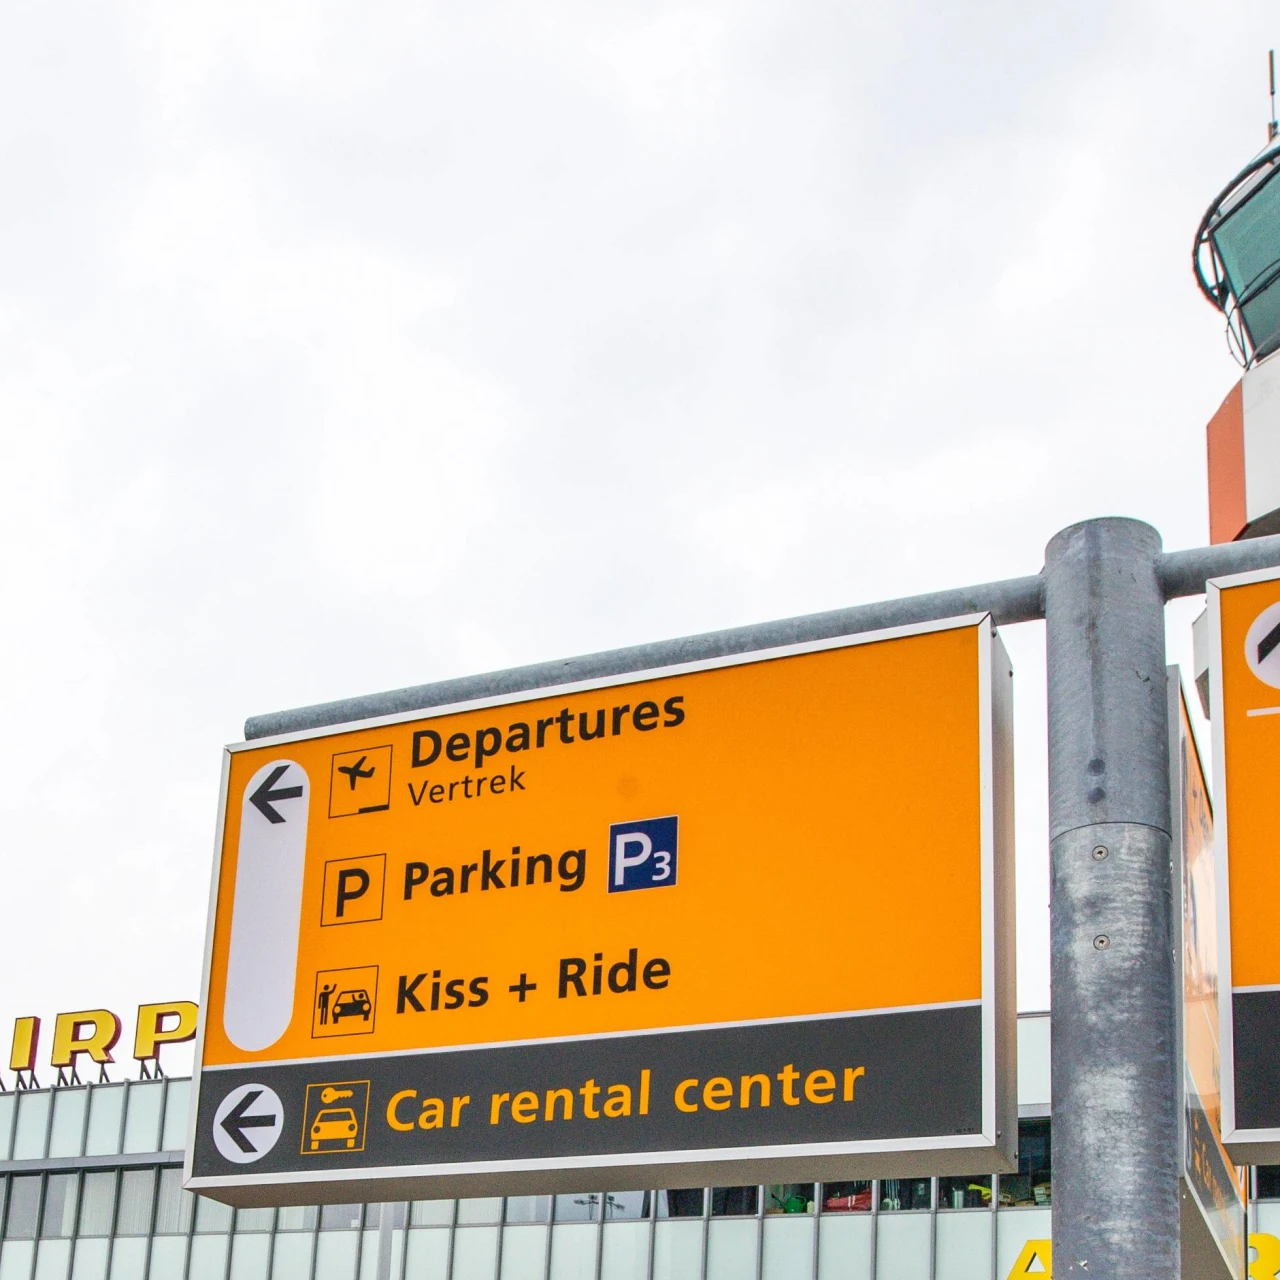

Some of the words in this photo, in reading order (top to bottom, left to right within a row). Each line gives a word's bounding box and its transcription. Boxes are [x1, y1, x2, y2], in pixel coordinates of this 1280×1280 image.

[410, 695, 685, 769] Departures
[408, 766, 526, 805] Vertrek
[336, 868, 370, 918] P
[403, 847, 586, 901] Parking
[614, 832, 671, 886] P3
[396, 969, 489, 1014] Kiss
[508, 973, 537, 1003] +
[558, 948, 671, 999] Ride
[386, 1089, 470, 1132] Car
[489, 1069, 651, 1125] rental
[674, 1063, 866, 1113] center
